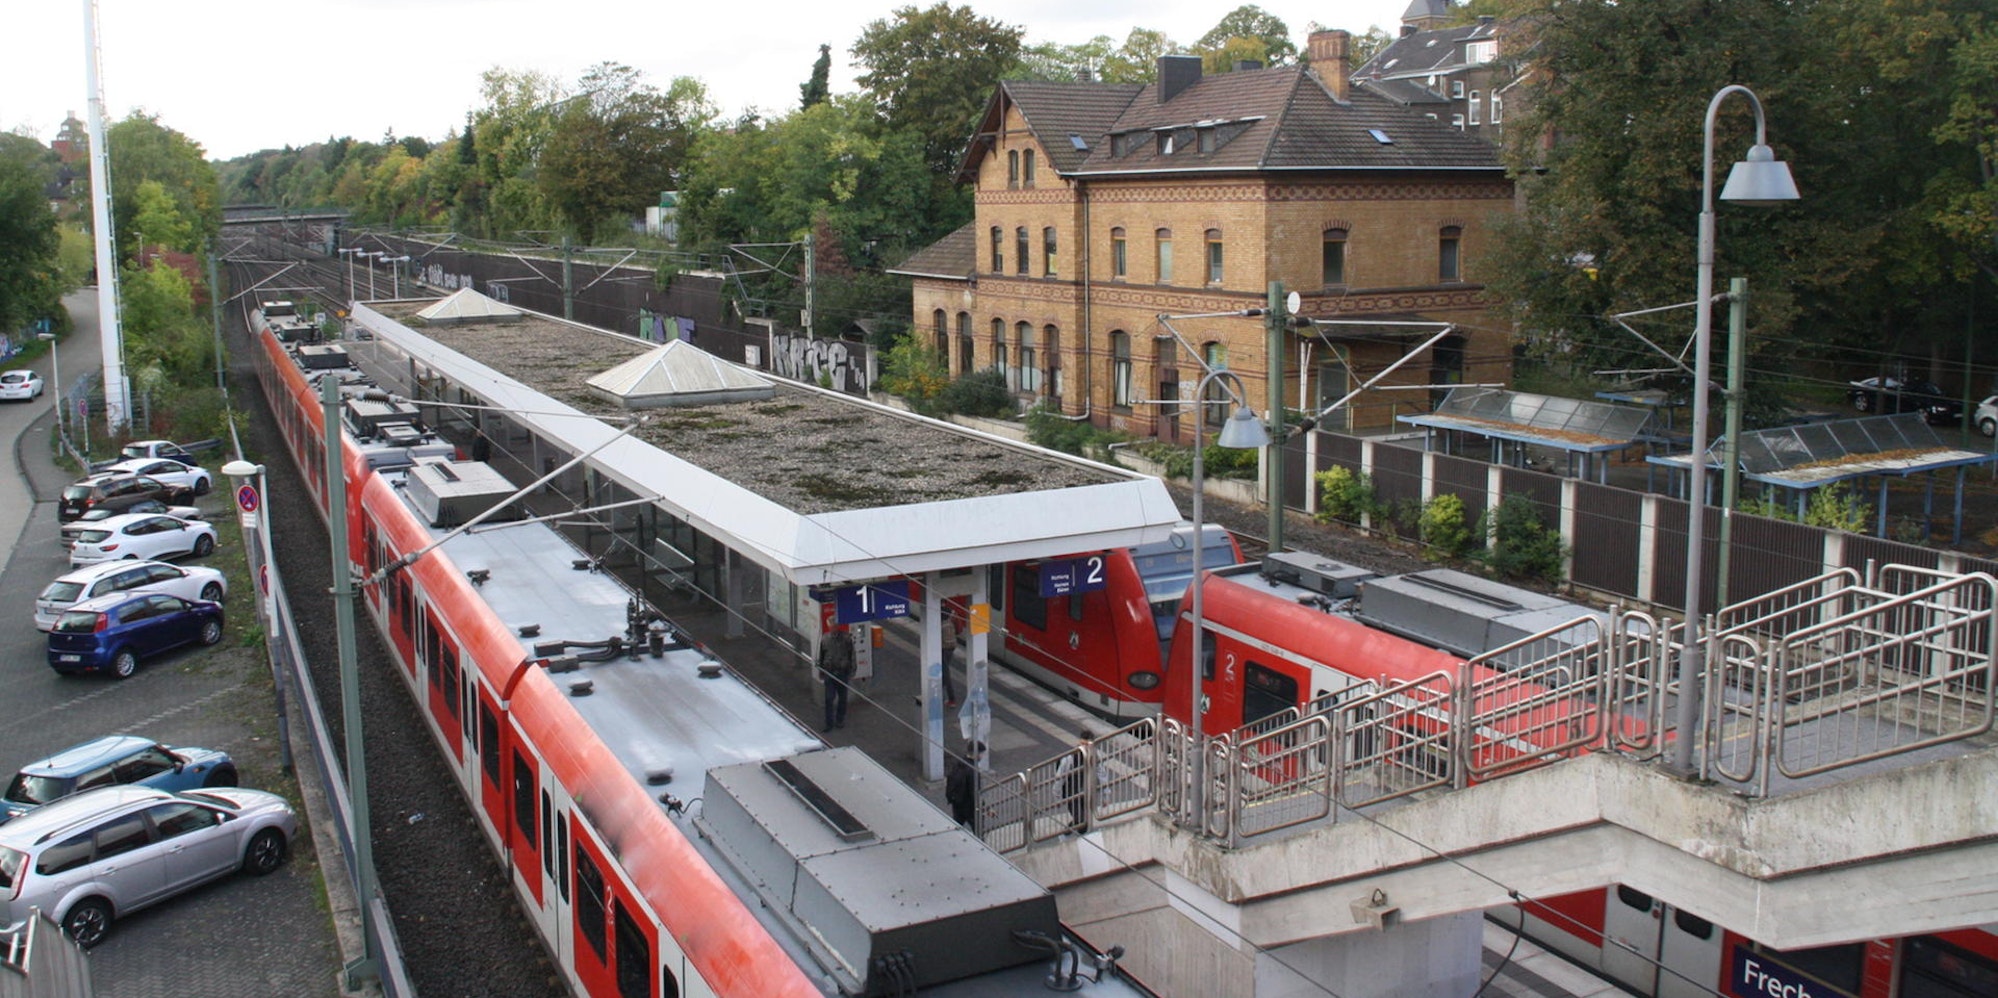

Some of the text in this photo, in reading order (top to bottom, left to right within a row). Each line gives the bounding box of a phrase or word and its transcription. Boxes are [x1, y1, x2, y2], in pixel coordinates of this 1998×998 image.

[1087, 556, 1103, 584] 2
[856, 584, 868, 614] 1
[1225, 653, 1235, 676] 2
